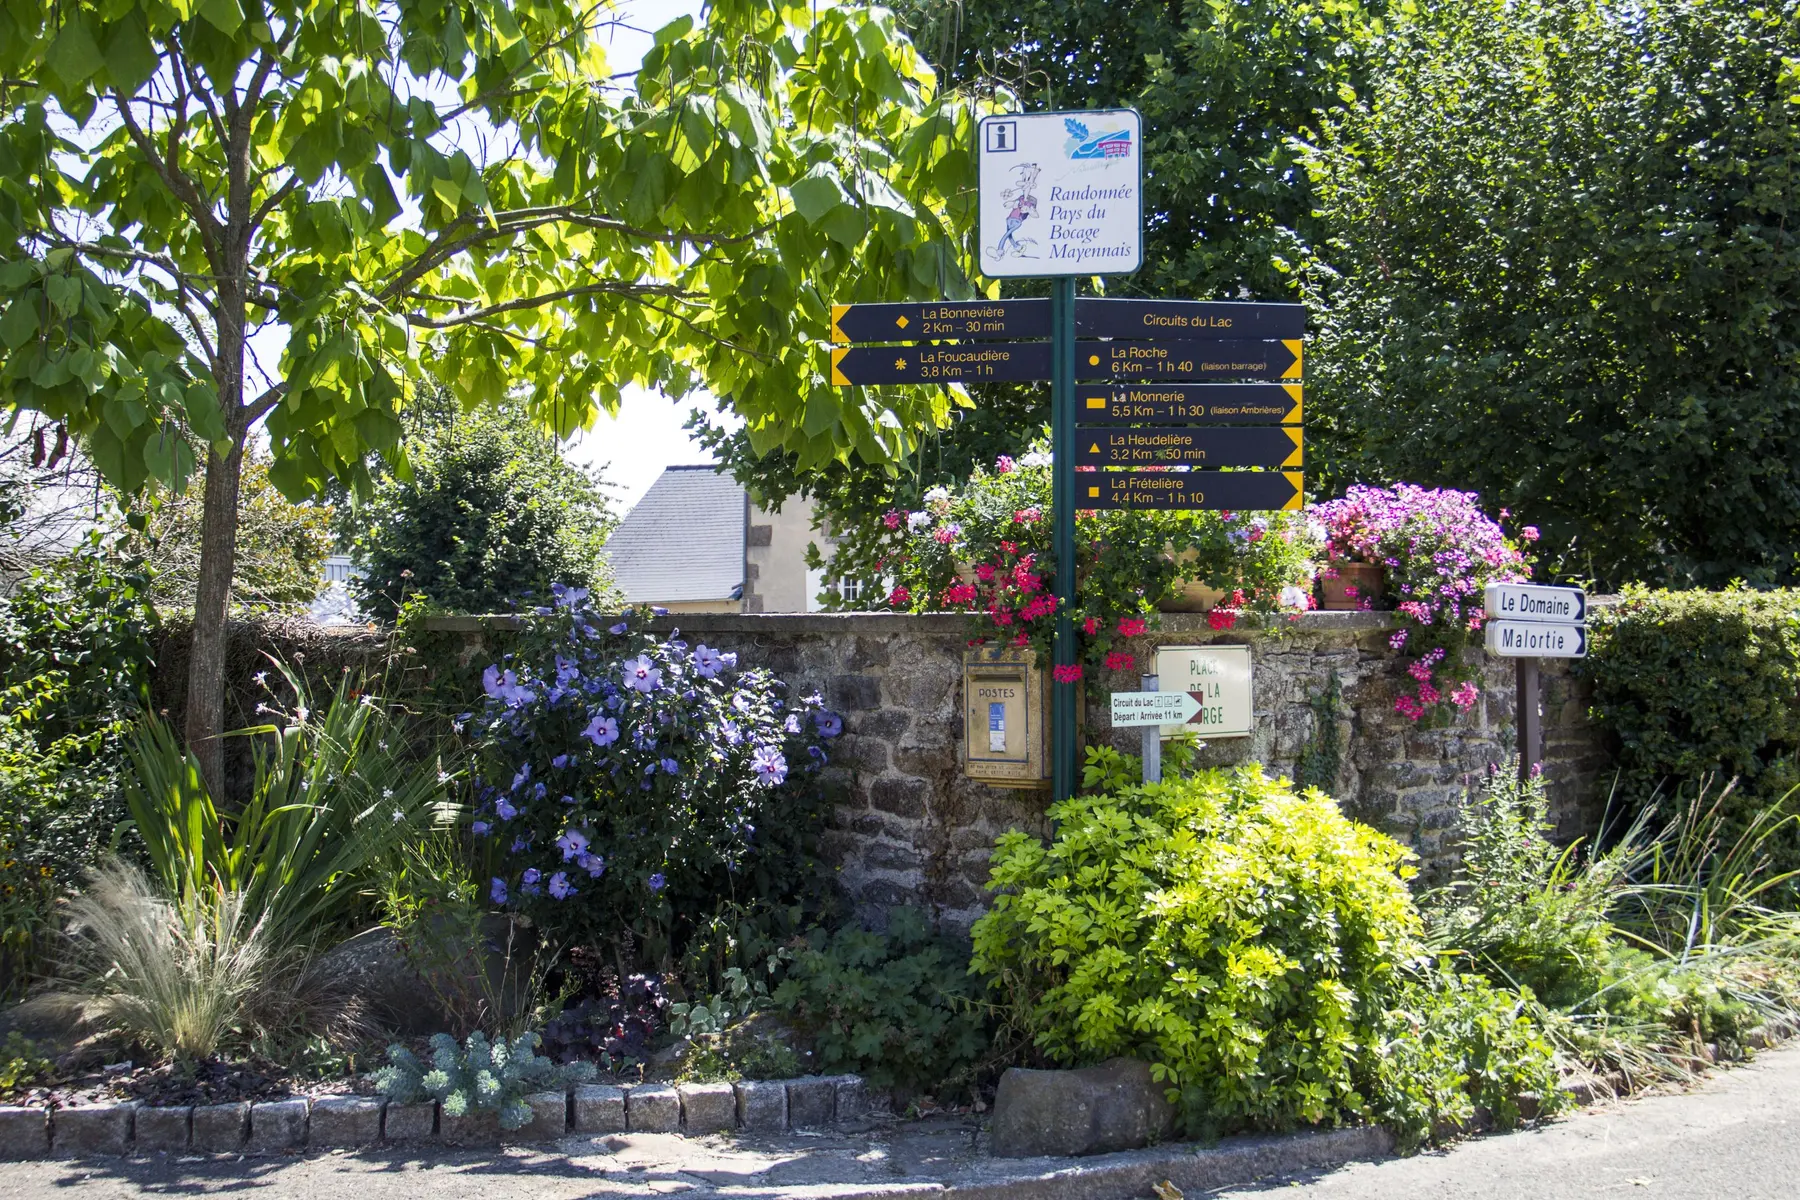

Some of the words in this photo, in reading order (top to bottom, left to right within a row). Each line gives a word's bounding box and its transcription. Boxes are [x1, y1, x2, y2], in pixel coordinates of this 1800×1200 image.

[1050, 184, 1132, 201] Randonnée
[1050, 205, 1082, 224] Pays
[1087, 204, 1106, 219] du
[1050, 224, 1099, 244] Bocage
[1049, 242, 1131, 262] Mayennais
[922, 308, 937, 320] La
[940, 307, 1005, 319] Bonnevière
[923, 323, 930, 334] 2
[933, 322, 953, 333] Km
[966, 321, 981, 333] 30
[983, 320, 1005, 331] min
[1143, 314, 1188, 327] Circuits
[1191, 316, 1207, 327] du
[1211, 316, 1233, 328] Lac
[920, 351, 936, 363] La
[938, 350, 1010, 363] Foucaudière
[1111, 347, 1127, 359] La
[1129, 347, 1168, 359] Roche
[920, 366, 939, 378] 3,8
[942, 365, 962, 377] Km
[976, 365, 982, 376] 1
[985, 364, 993, 375] h
[1112, 361, 1119, 372] 6
[1122, 361, 1142, 372] Km
[1157, 361, 1162, 372] 1
[1167, 361, 1175, 372] h
[1178, 361, 1193, 372] 40
[1201, 362, 1230, 371] (liaison
[1231, 362, 1267, 372] barrage)
[1112, 391, 1126, 402] La
[1130, 391, 1184, 402] Monnerie
[1112, 406, 1131, 417] 5,5
[1134, 406, 1154, 417] Km
[1168, 405, 1173, 416] 1
[1178, 405, 1186, 416] h
[1189, 405, 1204, 416] 30
[1210, 406, 1238, 416] (liaison
[1240, 406, 1285, 416] Ambrières)
[1110, 435, 1125, 445] La
[1128, 434, 1192, 446] Heudelière
[1110, 449, 1129, 460] 3,2
[1132, 449, 1152, 460] Km
[1165, 448, 1181, 460] 50
[1184, 448, 1206, 459] min
[1111, 478, 1126, 489] La
[1129, 477, 1184, 489] Frételière
[1112, 493, 1130, 504] 4,4
[1133, 492, 1154, 503] Km
[1168, 492, 1173, 503] 1
[1177, 492, 1186, 503] h
[1190, 492, 1204, 503] 10
[1501, 592, 1515, 612] Le
[1520, 594, 1570, 615] Domaine
[1502, 628, 1564, 649] Malortie
[978, 688, 1015, 698] POSTES
[1208, 682, 1220, 698] LA
[1113, 698, 1134, 707] Circuit
[1134, 698, 1142, 707] du
[1143, 698, 1154, 707] Lac
[1113, 711, 1135, 722] Départ
[1140, 711, 1163, 720] Arrivée
[1164, 711, 1172, 720] 11
[1173, 711, 1183, 720] km
